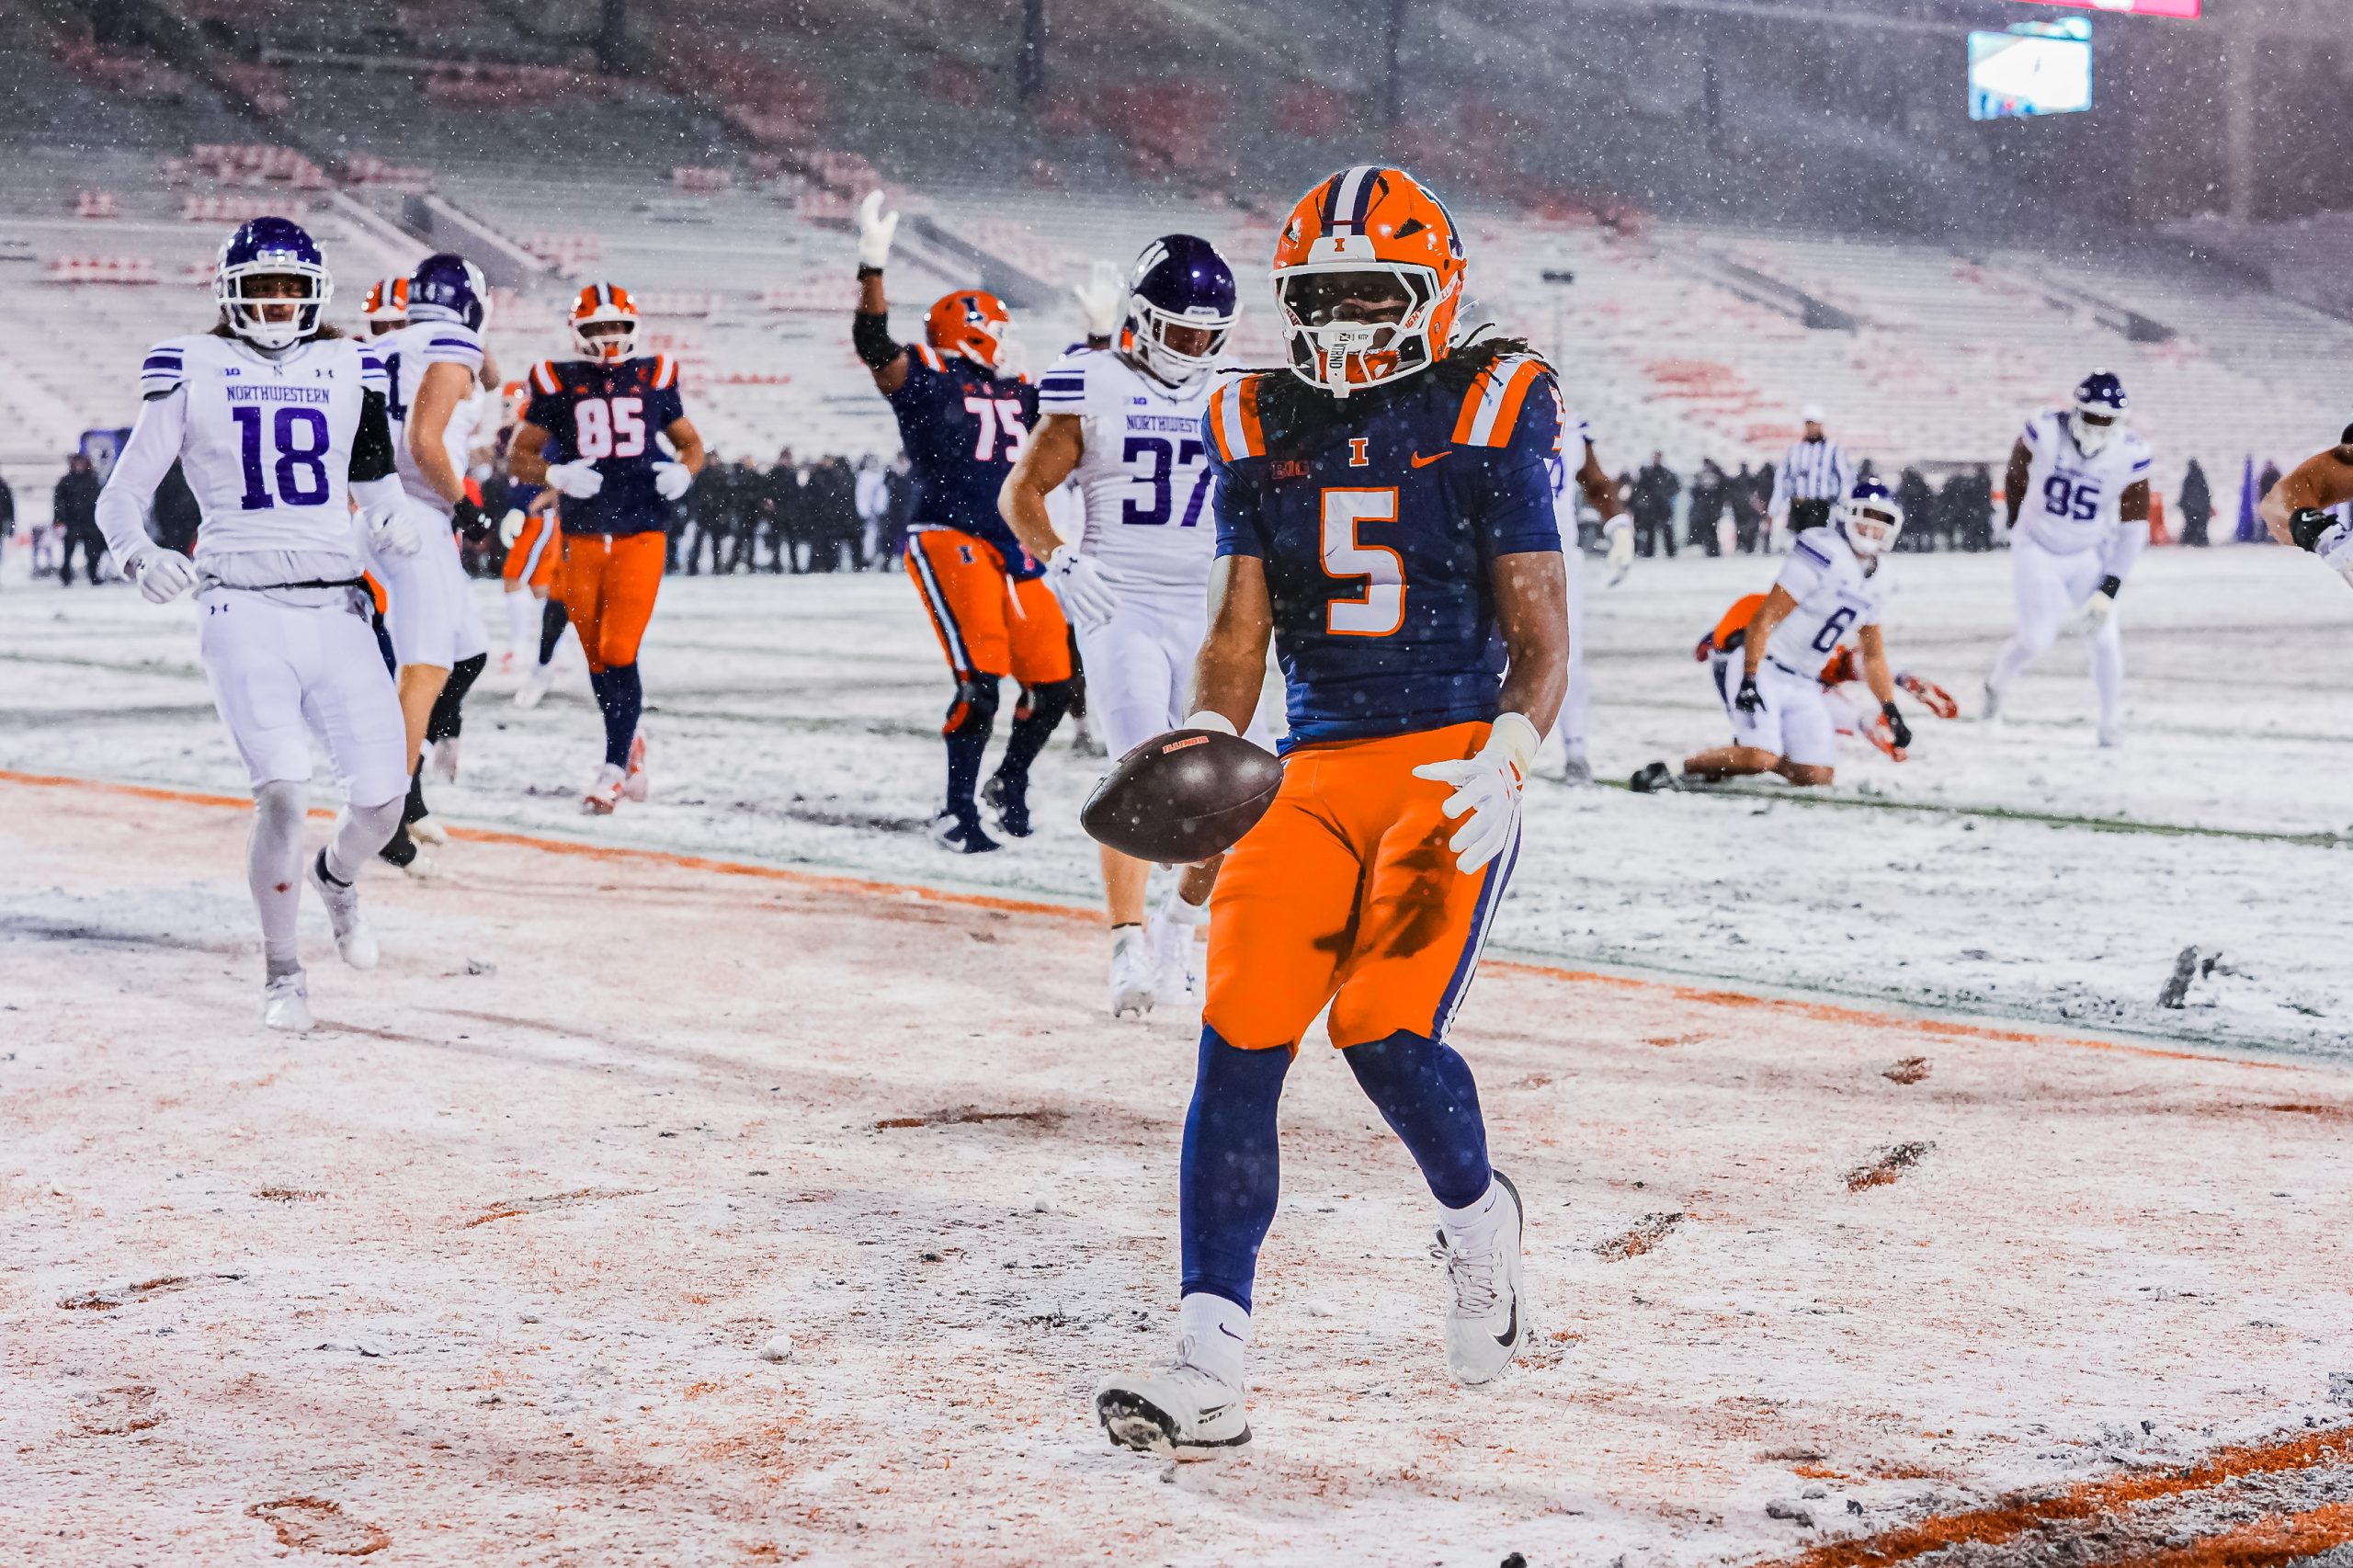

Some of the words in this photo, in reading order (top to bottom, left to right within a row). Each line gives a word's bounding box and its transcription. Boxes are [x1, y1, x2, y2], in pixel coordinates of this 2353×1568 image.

[1334, 237, 1346, 253] I
[226, 385, 330, 404] NORTHWESTERN
[574, 397, 645, 458] 85
[964, 396, 1030, 462] 75
[1126, 415, 1202, 433] NORTHWEST
[232, 406, 331, 511] 18
[1348, 437, 1370, 467] I
[1122, 437, 1213, 528] 37
[1319, 485, 1407, 637] 5
[1812, 606, 1858, 653] 6
